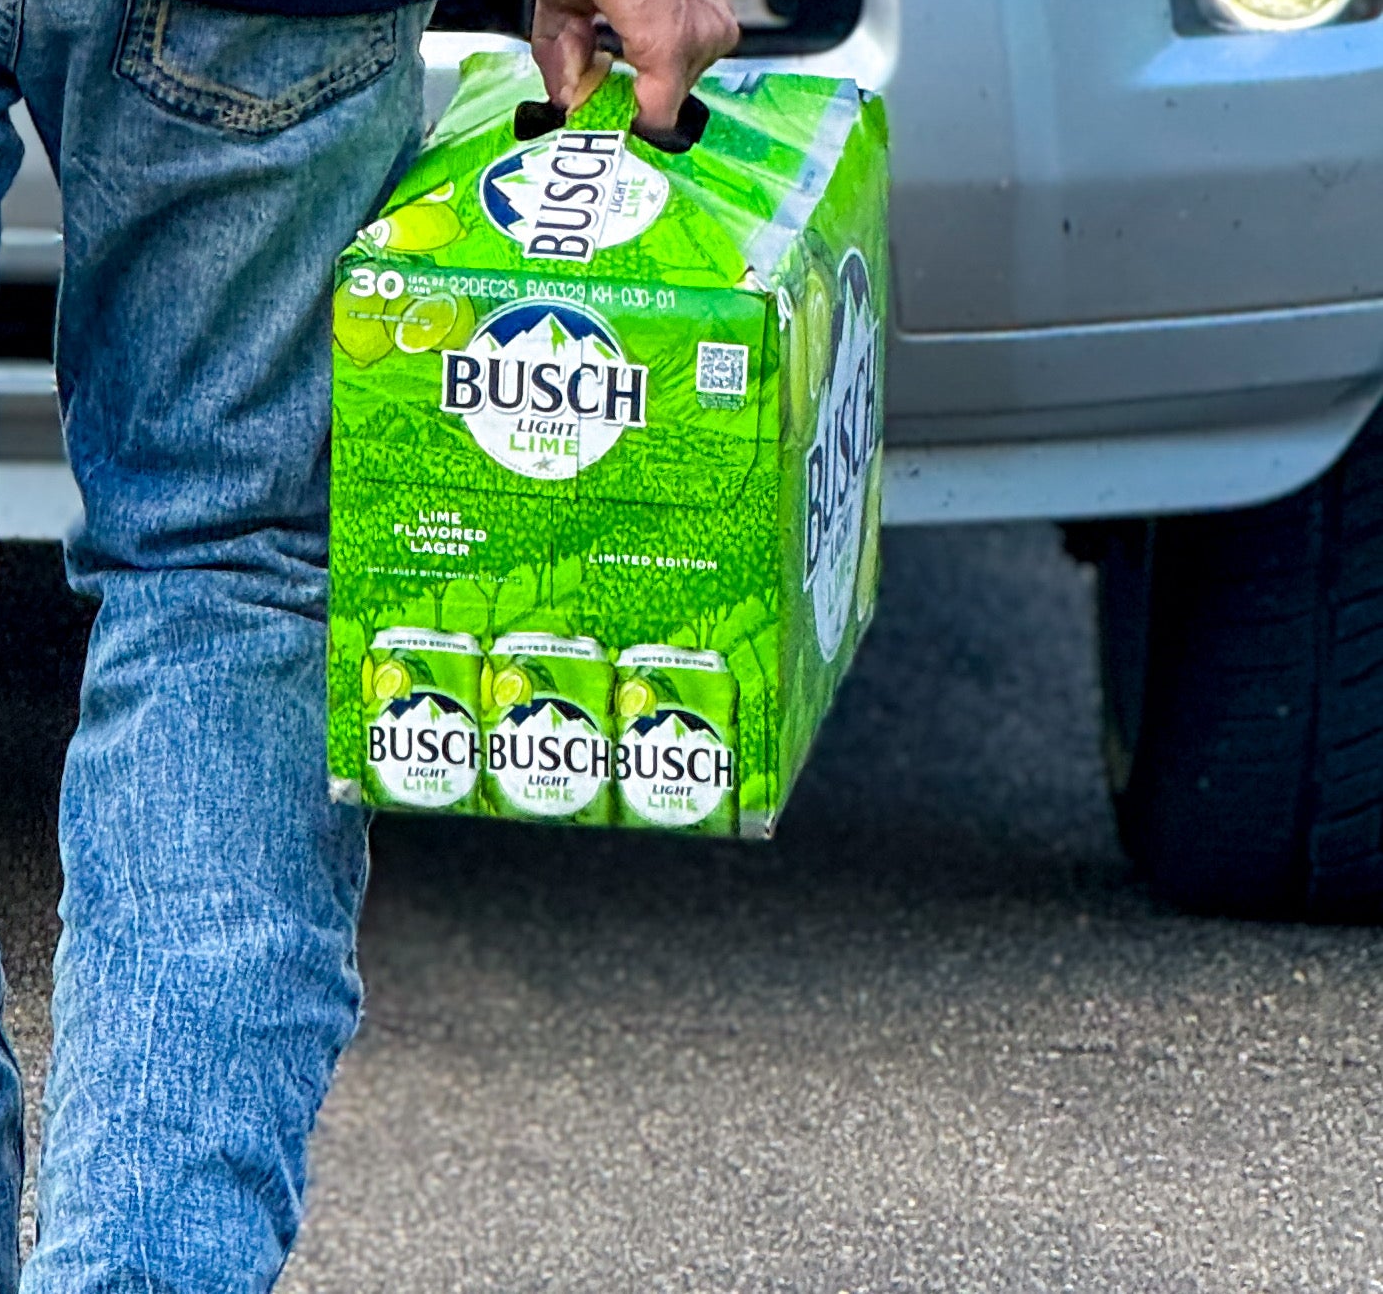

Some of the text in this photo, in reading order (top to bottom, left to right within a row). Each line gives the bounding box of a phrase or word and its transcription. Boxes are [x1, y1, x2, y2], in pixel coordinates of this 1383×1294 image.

[527, 133, 621, 259] BUSCH
[608, 179, 629, 214] LIGHT
[622, 177, 647, 219] LIME
[349, 268, 405, 300] 30
[449, 276, 518, 300] 22DEC25
[591, 285, 676, 309] KH-030-01
[444, 353, 644, 423] BUSCH
[516, 418, 578, 437] LIGHT
[508, 433, 579, 457] LIME
[418, 509, 462, 525] LIME
[393, 523, 487, 543] FLAVORED
[410, 540, 470, 557] LAGER
[588, 553, 718, 571] LIMITED EDITION
[488, 732, 610, 778] BUSCH
[407, 766, 450, 779] LIGHT
[616, 743, 733, 788] BUSCH
[402, 778, 453, 793] LIME
[527, 774, 571, 787] LIGHT
[651, 783, 694, 797] LIGHT
[522, 786, 575, 803] LIME
[647, 795, 698, 811] LIME
